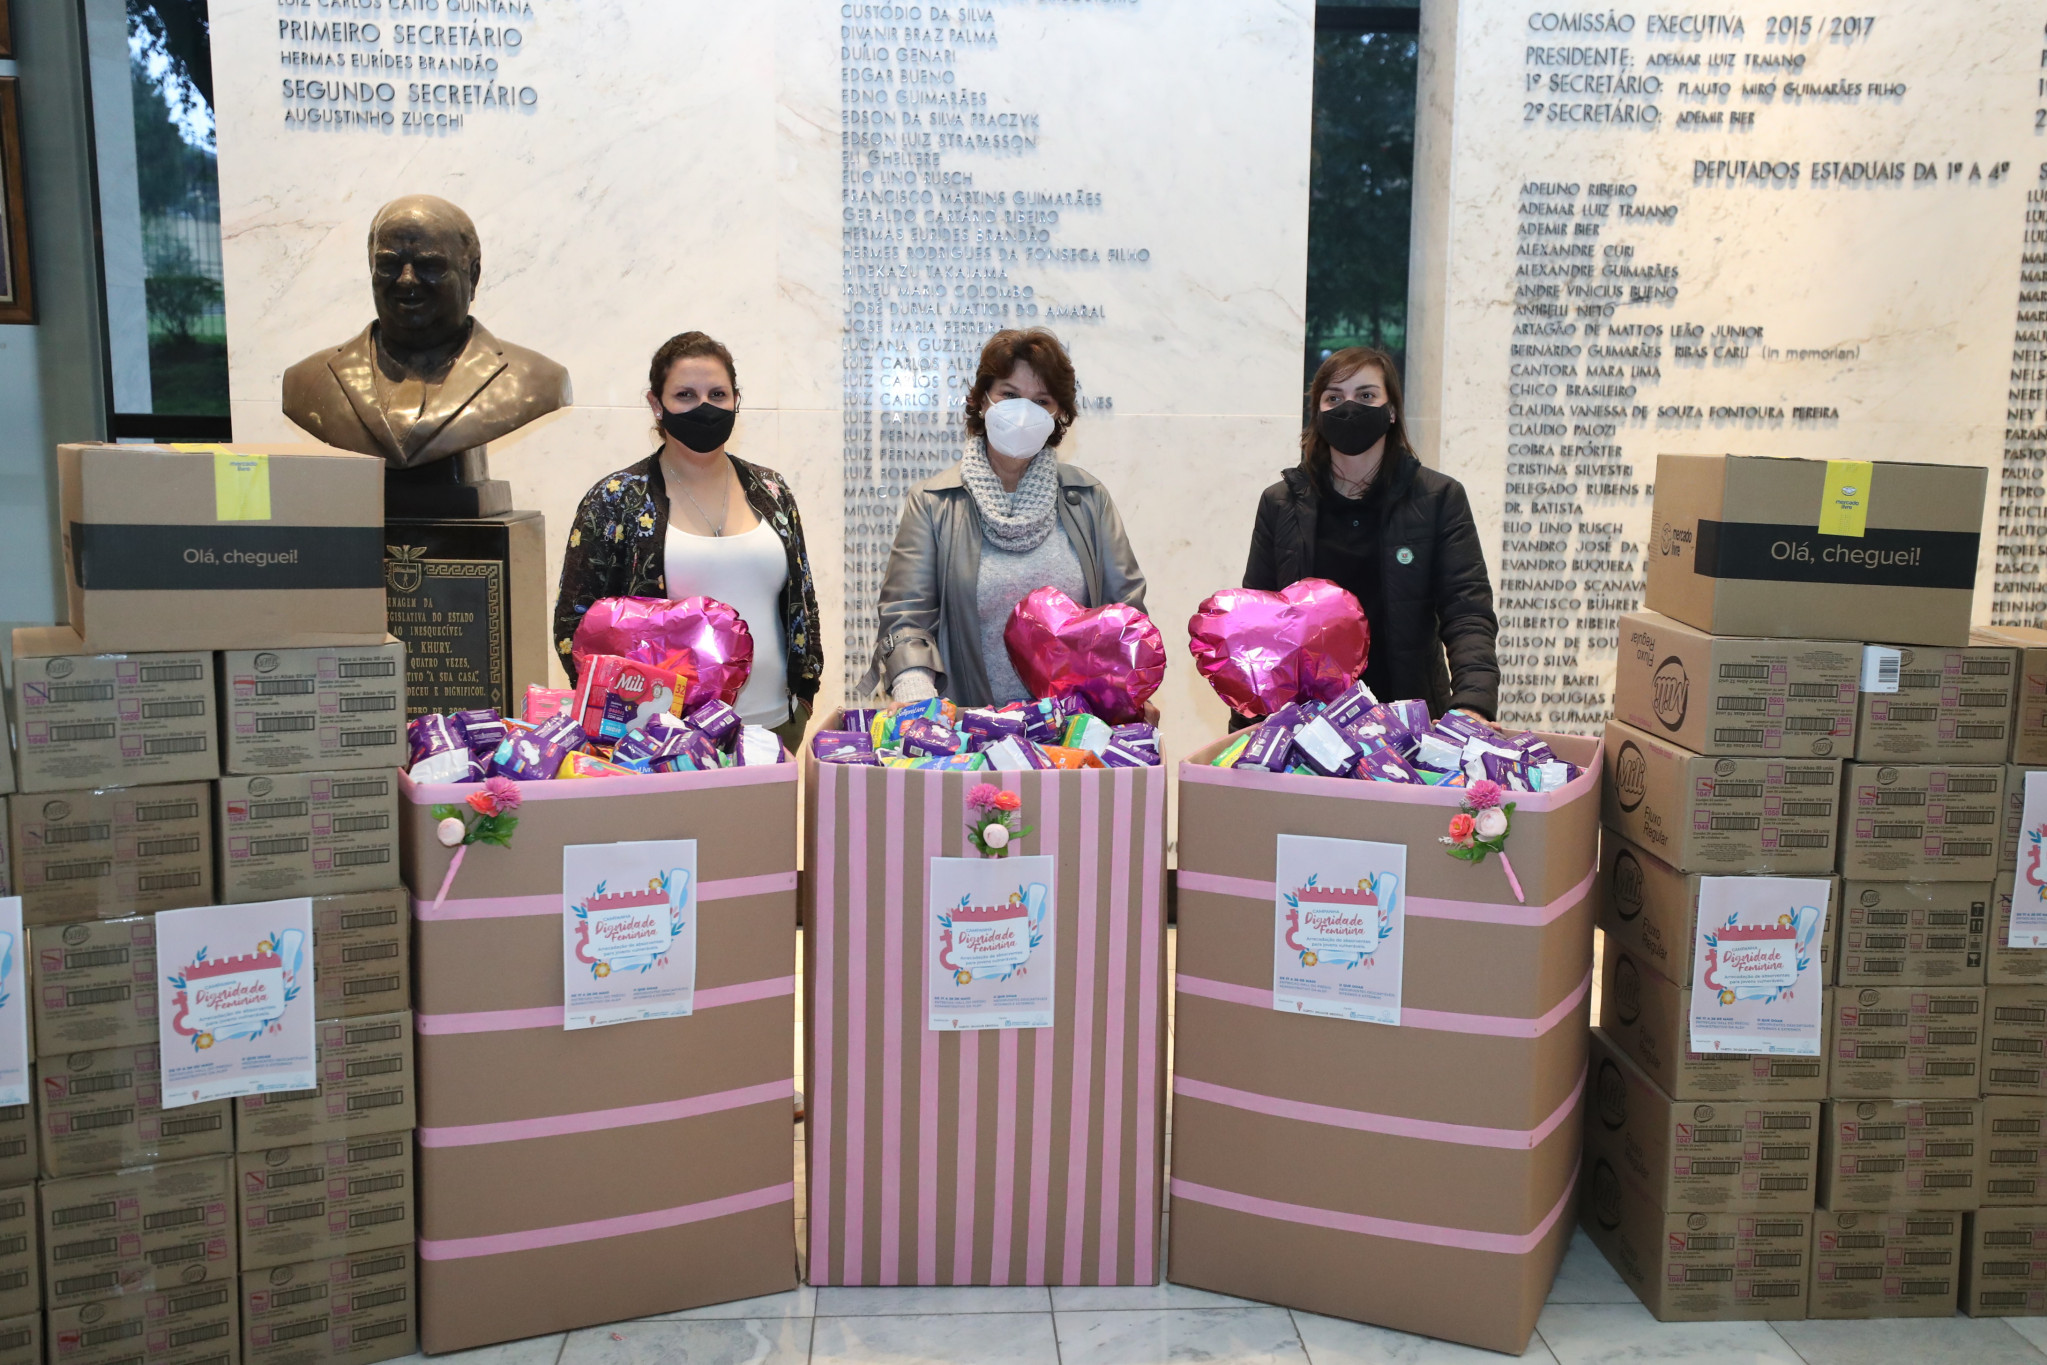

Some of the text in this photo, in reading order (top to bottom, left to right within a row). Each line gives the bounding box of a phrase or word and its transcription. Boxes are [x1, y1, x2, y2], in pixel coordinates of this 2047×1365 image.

[447, 0, 533, 15] QUINTANA
[841, 0, 994, 22] CUSTÓDIO DA SILVA
[1528, 9, 1635, 34] COMISSÃO
[1647, 15, 1744, 35] EXECUTIVA
[1766, 16, 1812, 35] 2015
[1831, 16, 1875, 36] 2017
[279, 18, 522, 47] PRIMEIRO SECRETÁRIO
[842, 26, 998, 44] DIVANIR BRAZ PALMA
[281, 49, 498, 71] HERMAS EURÍDES BRANDÃO
[842, 44, 956, 63] DUÍLIO GENARI
[1526, 47, 1805, 68] PRESIDENTE: ADEMAR LUIZ TRAIANO
[842, 68, 955, 84] EDGAR BUENO
[1549, 69, 1663, 95] SECRETÁRIO:
[1679, 82, 1731, 96] PLAUTO
[1741, 77, 1776, 96] MIRÓ
[1783, 80, 1862, 96] GUIMARÃES
[1867, 83, 1906, 96] FILHO
[283, 79, 537, 105] SEGUNDO SECRETÁRIO
[842, 89, 987, 105] EDNO GUIMARÃES
[285, 108, 463, 127] AUGUSTINHO ZUCCHI
[842, 110, 1039, 128] EDSON DA SILVA PRACZYK
[1547, 100, 1662, 124] SECRETÁRIO:
[1676, 111, 1723, 124] ADEMIR
[1730, 111, 1754, 125] BIER
[1694, 160, 1799, 180] DEPUTADOS
[1812, 161, 1905, 180] ESTADUAIS
[1914, 162, 1937, 180] DA
[1968, 162, 1981, 180] A
[843, 189, 1101, 207] FRANCISCO MARTINS GUIMARÃES
[1520, 183, 1637, 196] ADELINO RIBEIRO
[1519, 203, 1678, 218] ADEMAR LUIZ TRAIANO
[1518, 223, 1600, 236] ADEMIR BIER
[843, 246, 1150, 262] HERMES RODRIGUES DA FONSECA FILHO
[1517, 244, 1634, 258] ALEXANDRE CURI
[1513, 322, 1764, 339] ARTAGÃO DE MATTOS LEÃO JUNIOR
[1511, 345, 1581, 358] BERNARDO
[1588, 342, 1661, 358] GUIMARÃES
[1675, 347, 1707, 359] RIBAS
[1762, 347, 1779, 360] (in
[1511, 364, 1661, 379] CANTORA MARA LIMA
[1510, 384, 1637, 397] CHICO BRASILEIRO
[1509, 404, 1838, 419] CLAUDIA VANESSA DE SOUZA FONTOURA PEREIRA
[1508, 441, 1622, 457] COBRA REPÓRTER
[1507, 464, 1632, 476] CRISTINA SILVESTRI
[1505, 502, 1583, 514] DR. BATISTA
[1504, 522, 1622, 534] ELIO LINO RUSCH
[1672, 528, 1692, 544] mercado
[183, 548, 298, 567] Olá, cheguei!
[1771, 541, 1921, 569] Olá, cheguei!
[424, 598, 432, 608] DA
[1500, 593, 1638, 611] FRANCISCO BÜHRER
[433, 613, 473, 622] DO ESTADO
[394, 624, 462, 637] AO INESQUECÍVEL
[421, 642, 452, 653] KHURY.
[1631, 632, 1655, 651] Regular
[411, 658, 470, 669] QUATRO VEZES,
[1498, 655, 1578, 667] GUTO SILVA
[1637, 649, 1654, 667] Fluxo
[440, 672, 453, 682] SUA
[614, 673, 645, 694] Mili
[434, 687, 485, 696] E DIGNIFICOU.
[675, 684, 686, 696] 32
[1654, 677, 1689, 715] Mili
[1615, 756, 1646, 795] Mili
[1644, 806, 1661, 826] Fluxo
[1643, 822, 1668, 846] Regular
[1305, 912, 1363, 929] Dignidade
[1320, 925, 1365, 935] Feminina
[1723, 948, 1781, 967] Dignidade
[1738, 961, 1784, 972] Feminina
